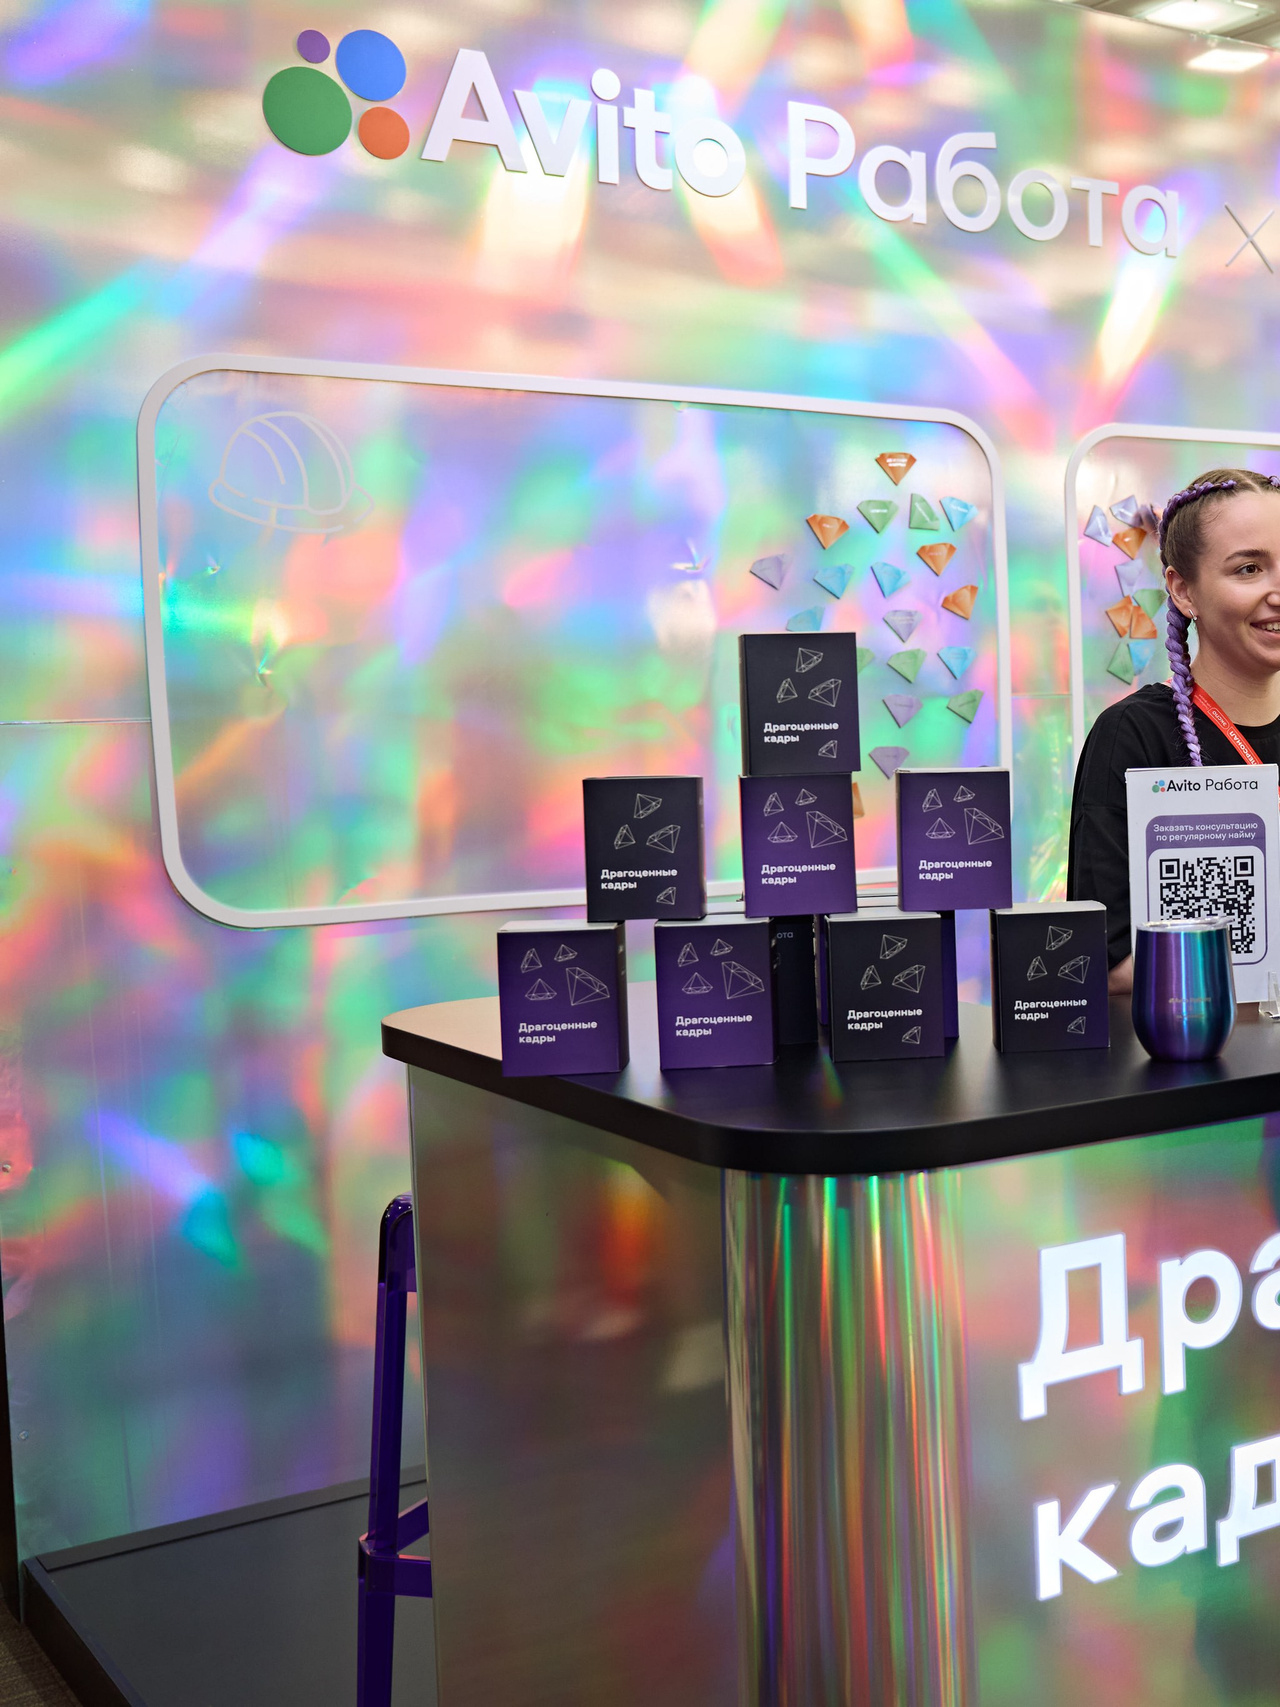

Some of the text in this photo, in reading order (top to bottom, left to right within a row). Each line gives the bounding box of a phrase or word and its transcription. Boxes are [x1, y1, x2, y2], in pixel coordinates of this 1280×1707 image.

[421, 48, 1181, 258] Avito Работа
[763, 722, 839, 733] Драгоценные
[764, 735, 800, 744] кадры
[1212, 710, 1257, 765] ПЕРСОНАЛ ЭКСПО
[1166, 778, 1258, 792] Avito Работа
[1153, 822, 1258, 832] Заказать консультацию
[1169, 833, 1227, 842] регулярному
[1228, 831, 1256, 840] найму
[761, 863, 836, 875] Драгоценные
[918, 860, 993, 871] Драгоценные
[600, 869, 678, 880] Драгоценные
[919, 872, 954, 882] кадры
[601, 882, 637, 891] кадры
[761, 876, 797, 886] кадры
[776, 931, 794, 939] ота
[1014, 999, 1088, 1010] Драгоценные
[847, 1009, 923, 1020] Драгоценные
[1014, 1012, 1049, 1021] кадры
[675, 1015, 753, 1027] Драгоценные
[847, 1022, 883, 1031] кадры
[518, 1021, 598, 1033] Драгоценные
[676, 1028, 712, 1038] кадры
[519, 1035, 556, 1044] кадры
